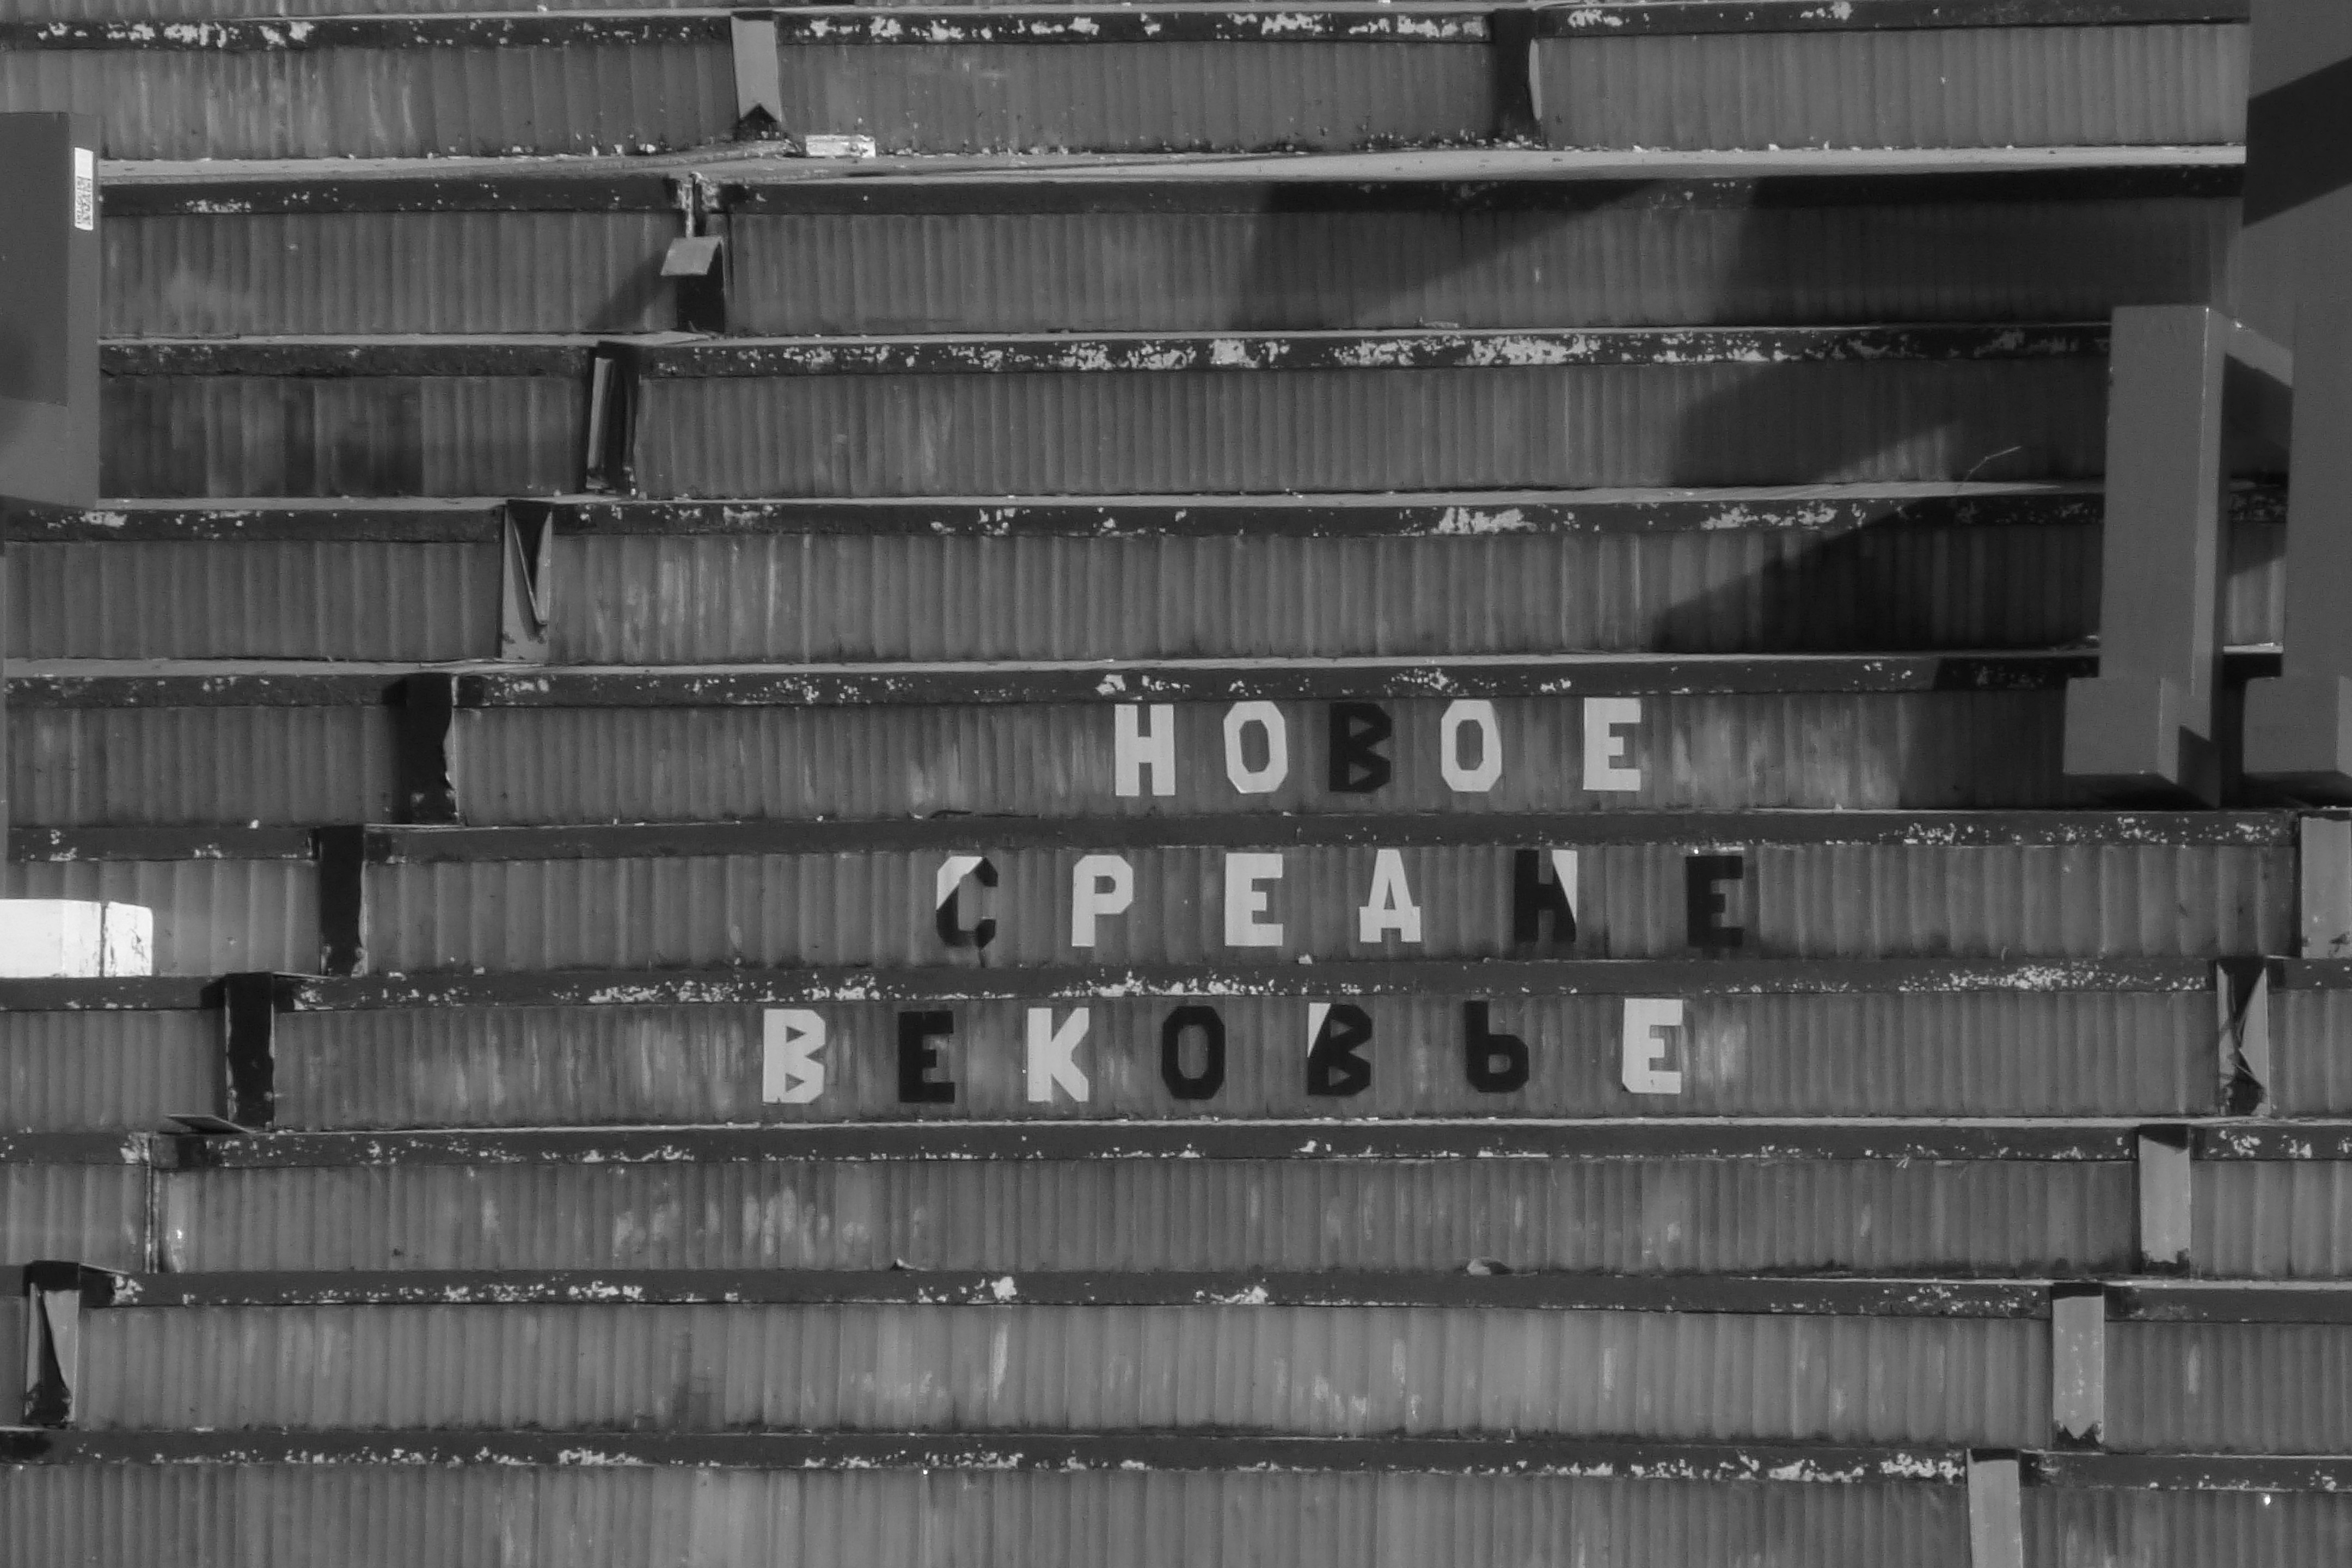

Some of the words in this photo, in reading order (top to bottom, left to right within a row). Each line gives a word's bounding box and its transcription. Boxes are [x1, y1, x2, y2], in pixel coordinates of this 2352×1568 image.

[1114, 697, 1641, 797] НОВОЕ
[936, 849, 1743, 948] СРЕДНЕ
[762, 998, 1683, 1104] ВЕКОВЬЕ
